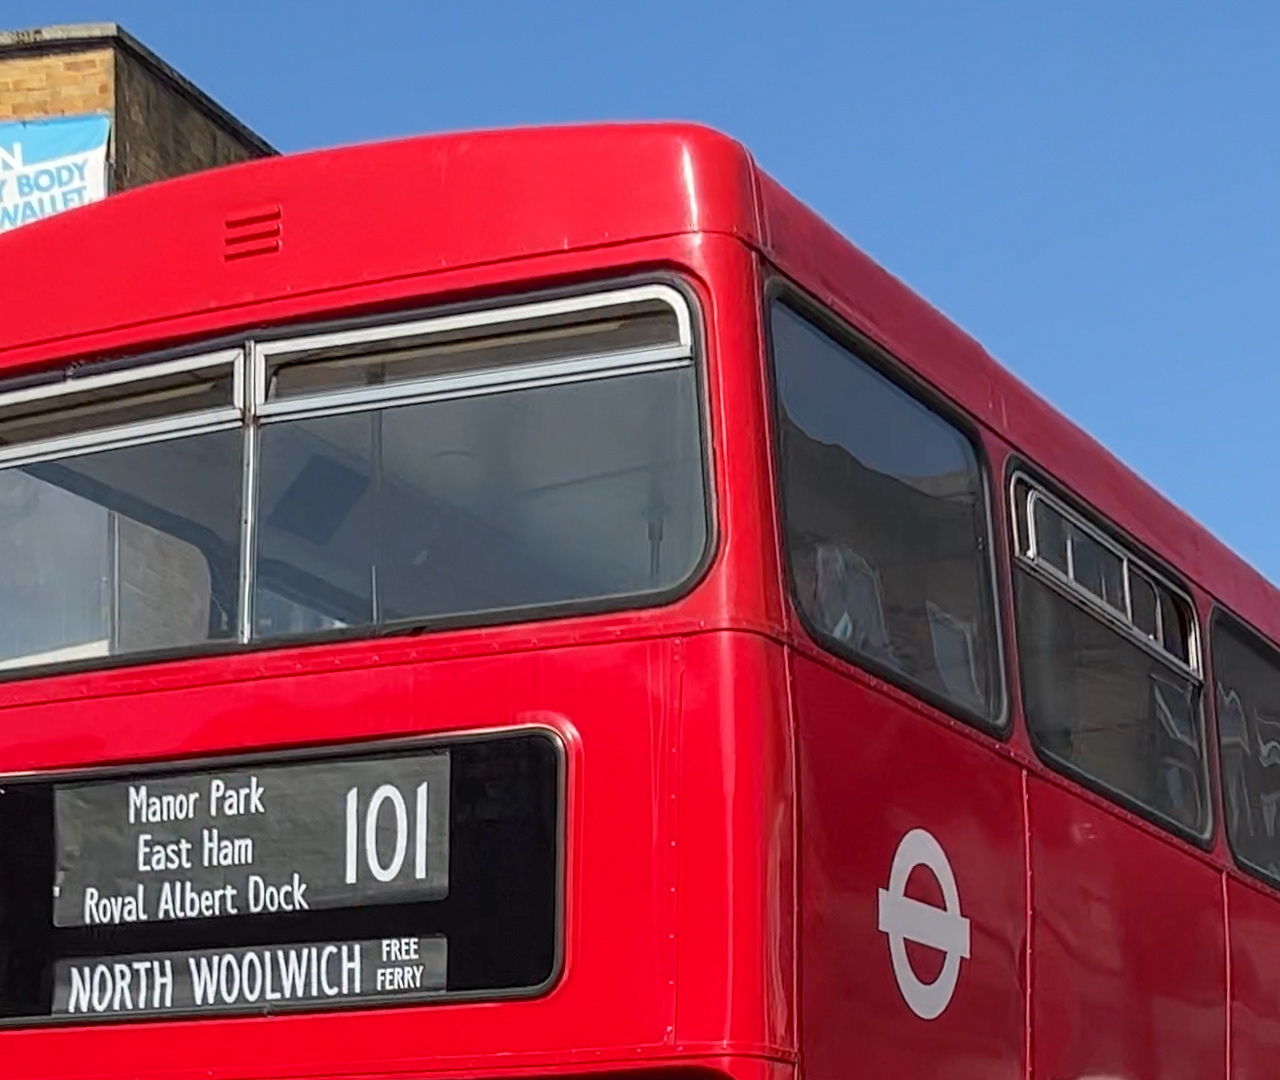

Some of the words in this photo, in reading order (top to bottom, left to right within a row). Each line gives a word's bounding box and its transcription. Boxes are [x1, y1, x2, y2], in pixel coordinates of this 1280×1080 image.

[16, 158, 89, 198] BODY
[128, 785, 199, 823] Manor
[210, 776, 266, 817] Park
[137, 833, 192, 872] East
[202, 829, 253, 867] Ham
[345, 782, 427, 884] 101
[158, 880, 238, 920] Albert
[248, 873, 309, 913] Dock
[381, 938, 419, 962] FREE
[68, 959, 173, 1014] NORTH
[189, 944, 361, 1005] WOOLWICH
[376, 966, 424, 991] FERRY
